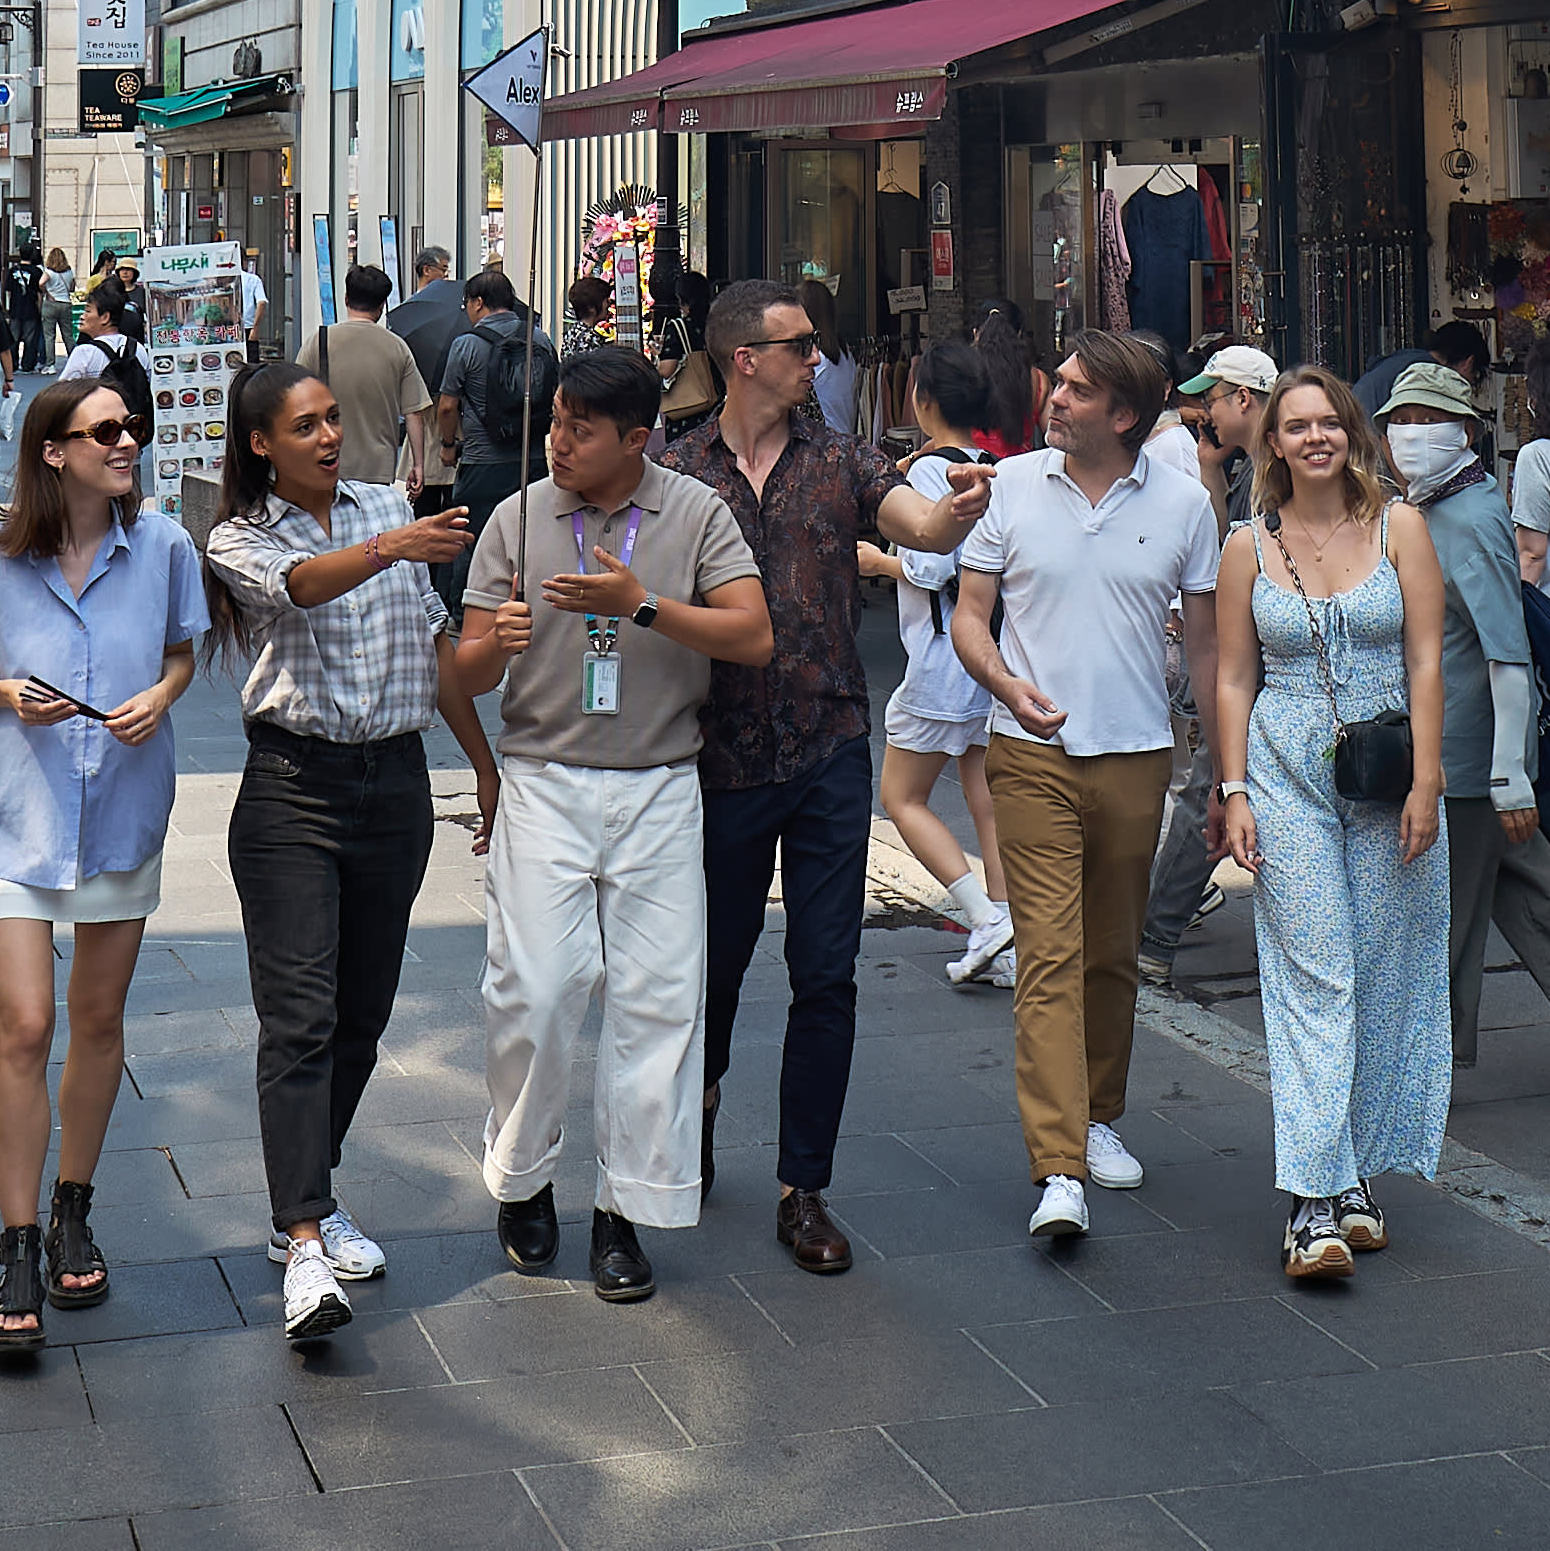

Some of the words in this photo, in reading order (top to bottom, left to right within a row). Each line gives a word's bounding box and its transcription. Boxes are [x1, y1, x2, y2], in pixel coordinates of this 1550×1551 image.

[86, 41, 105, 49] Tea
[107, 41, 139, 49] House
[86, 50, 114, 59] Since
[116, 50, 140, 59] 2011
[506, 76, 540, 104] Alex
[84, 106, 100, 114] TEA
[161, 253, 209, 274] 나무새
[215, 324, 240, 341] 카페
